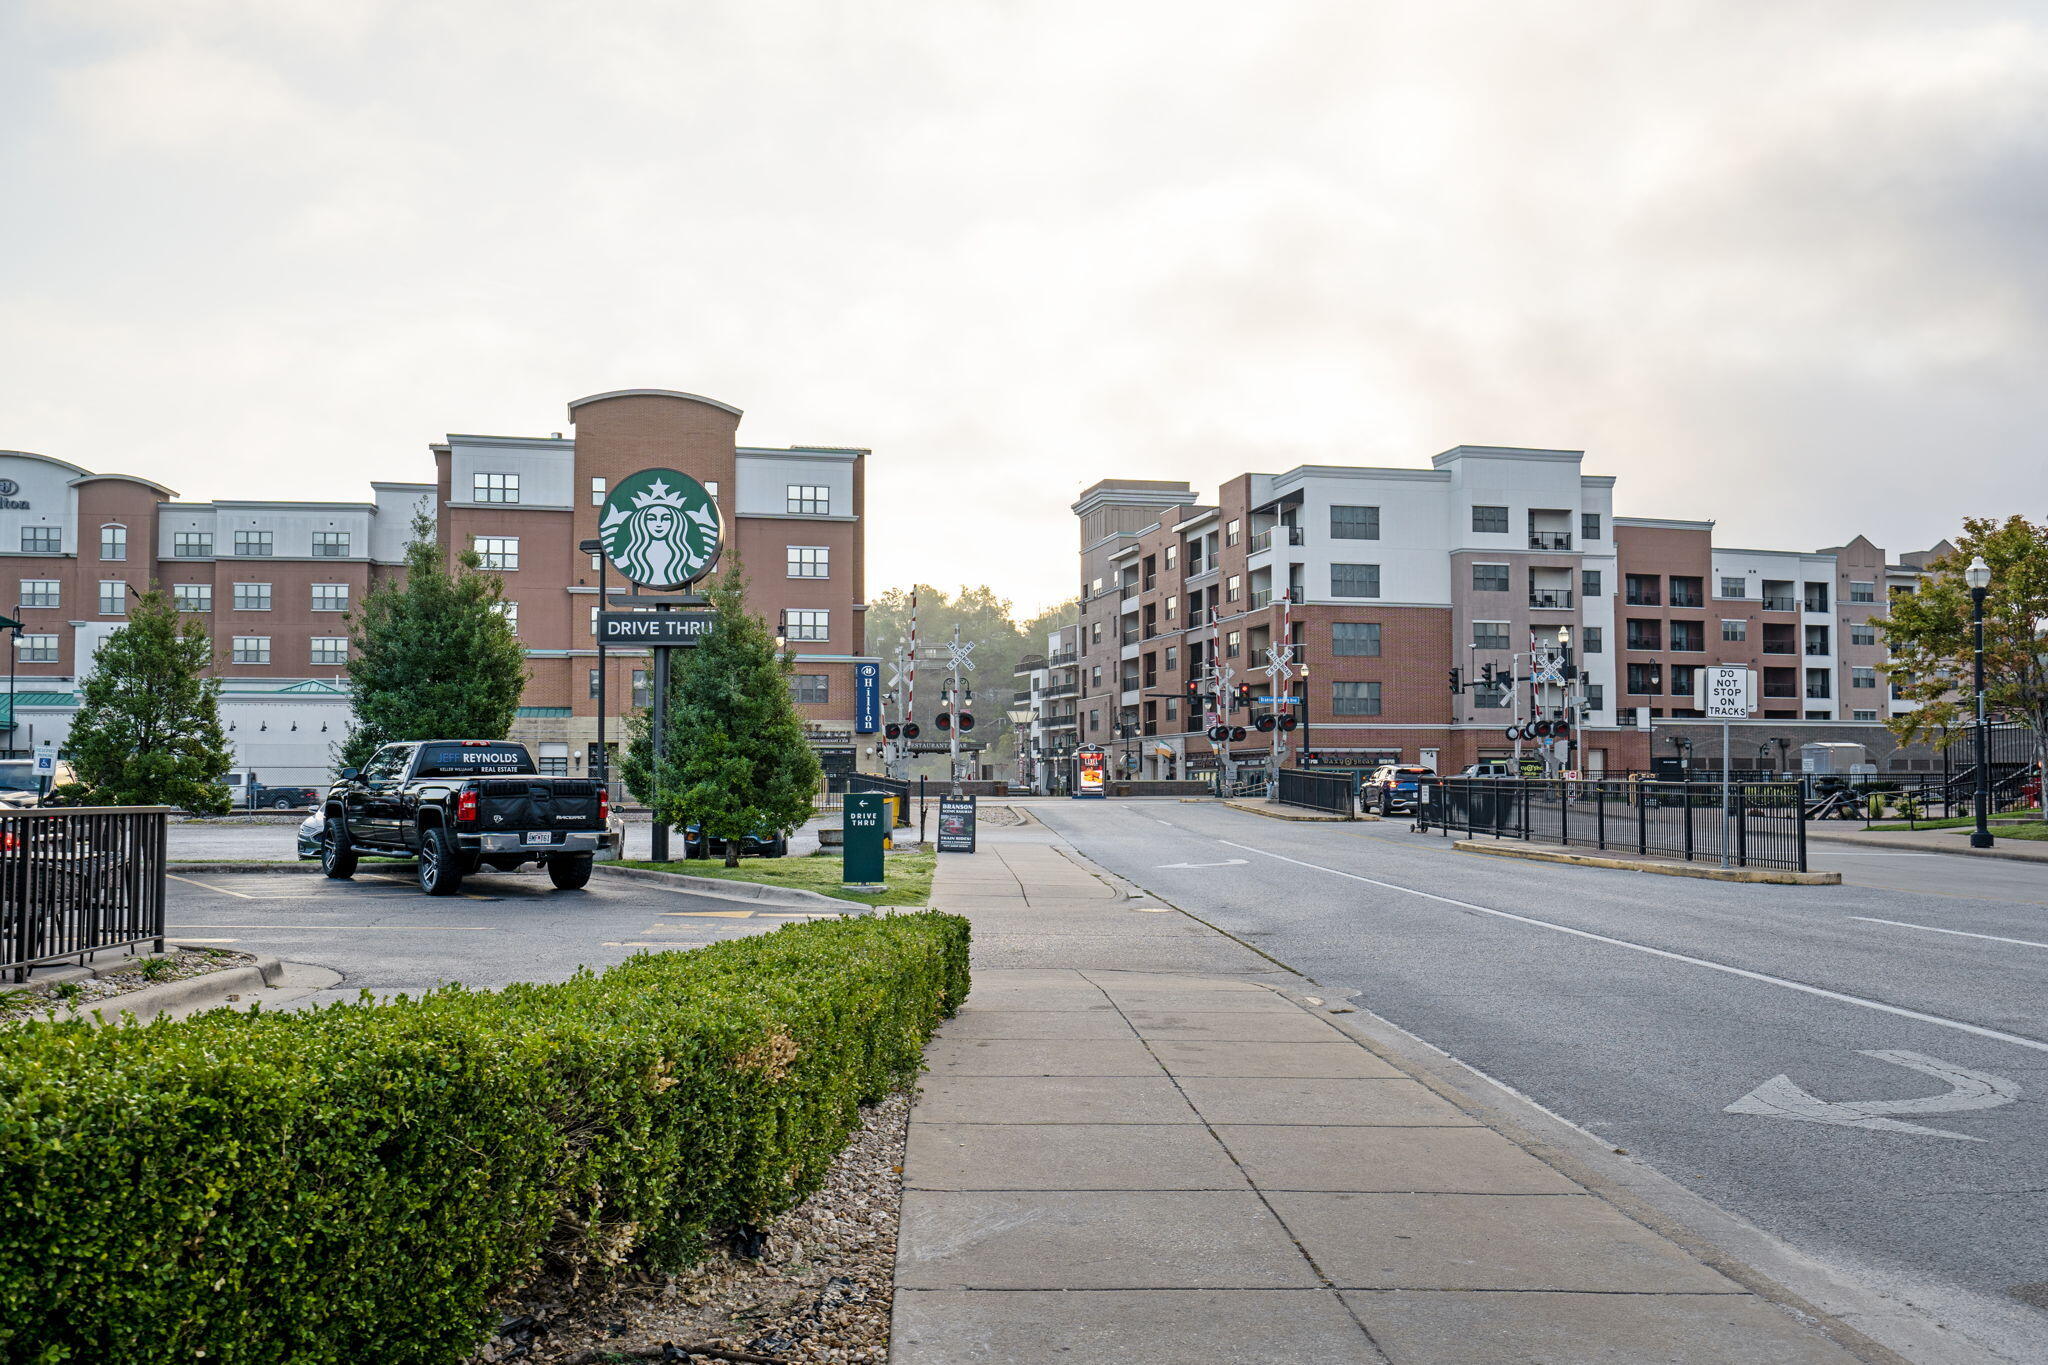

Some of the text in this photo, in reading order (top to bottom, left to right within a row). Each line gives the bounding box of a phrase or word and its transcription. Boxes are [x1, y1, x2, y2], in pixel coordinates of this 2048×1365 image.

[607, 621, 713, 635] DRIVE THRU
[1716, 679, 1738, 687] NOT
[1713, 688, 1741, 696] STOP
[864, 678, 873, 729] Hilton
[1720, 698, 1735, 706] ON
[1709, 706, 1746, 716] TRACKS
[437, 753, 518, 763] JEFF REYNOLDS
